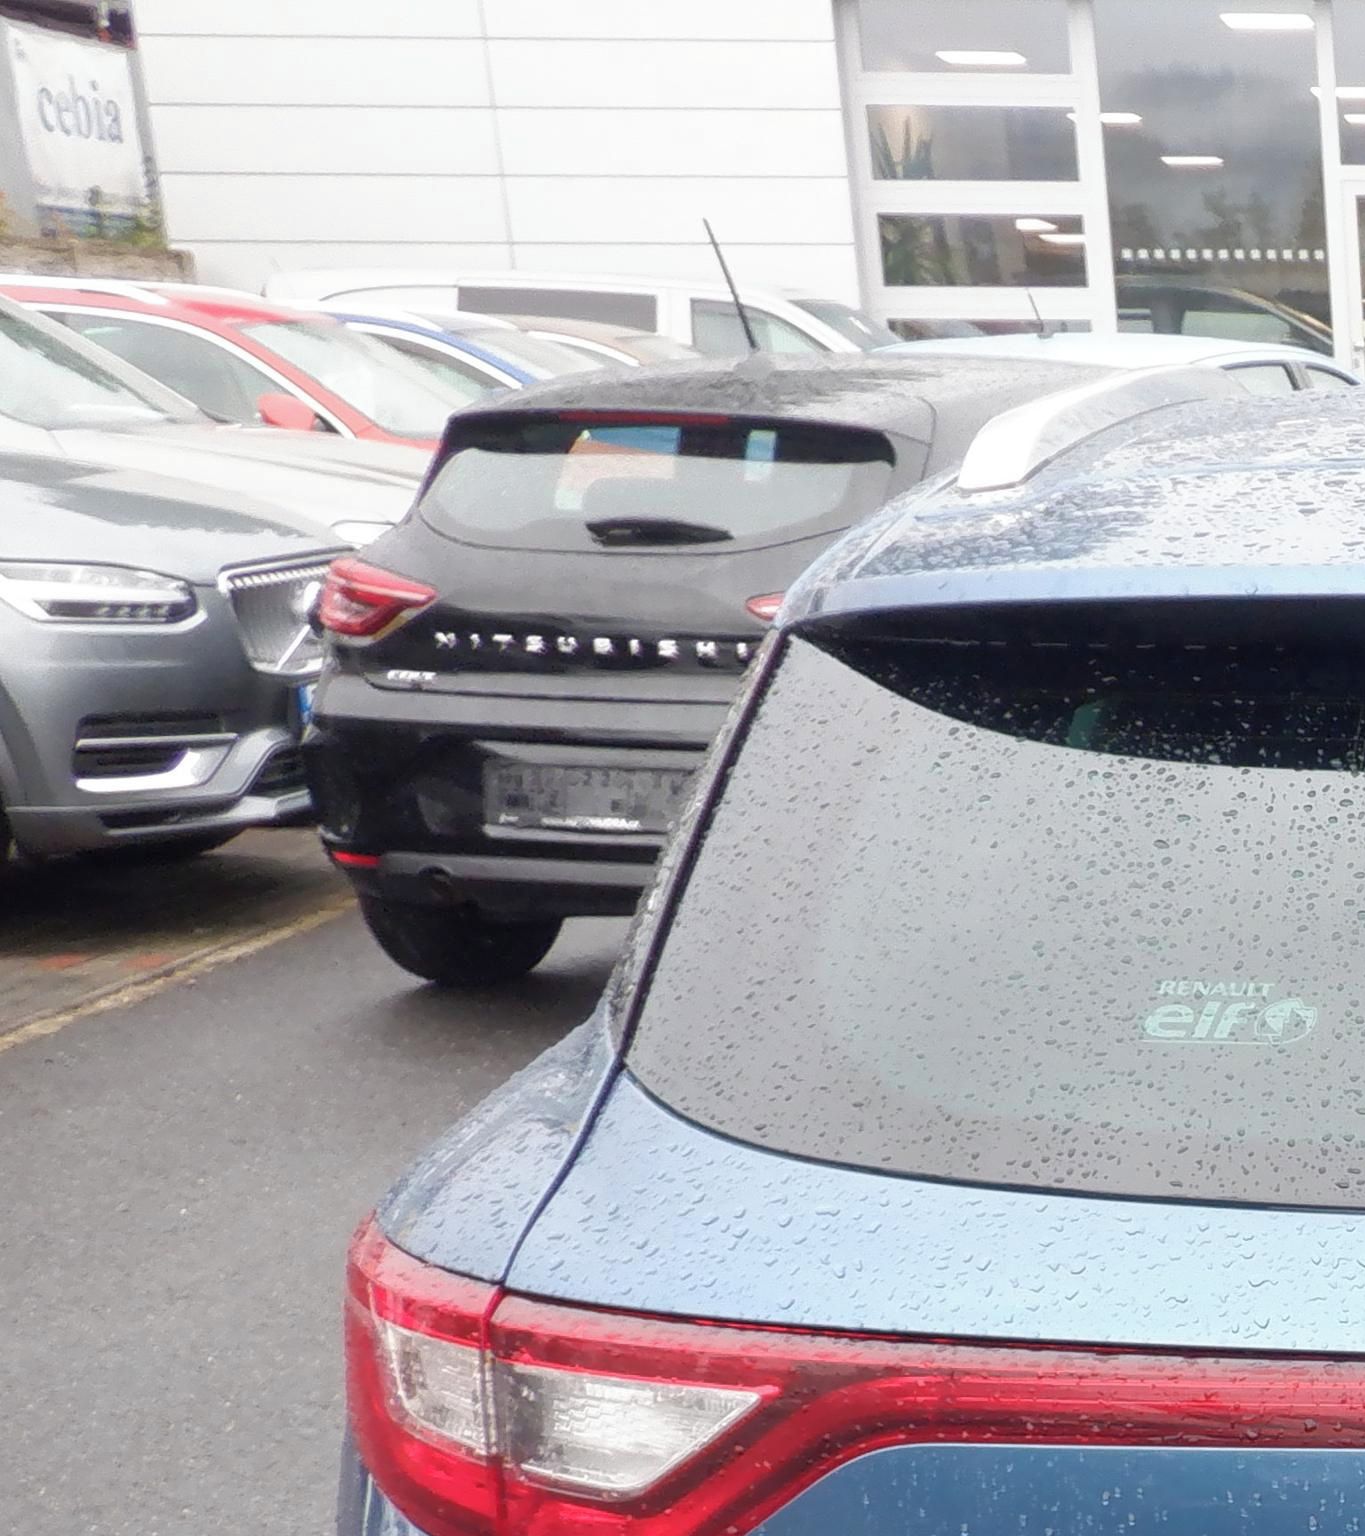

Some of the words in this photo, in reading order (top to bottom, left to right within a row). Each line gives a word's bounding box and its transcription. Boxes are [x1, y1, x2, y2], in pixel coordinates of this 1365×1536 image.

[37, 74, 123, 143] cebia
[434, 631, 749, 663] MITSUBISHI
[1158, 979, 1275, 997] RENAULT
[1144, 1001, 1255, 1039] elf
